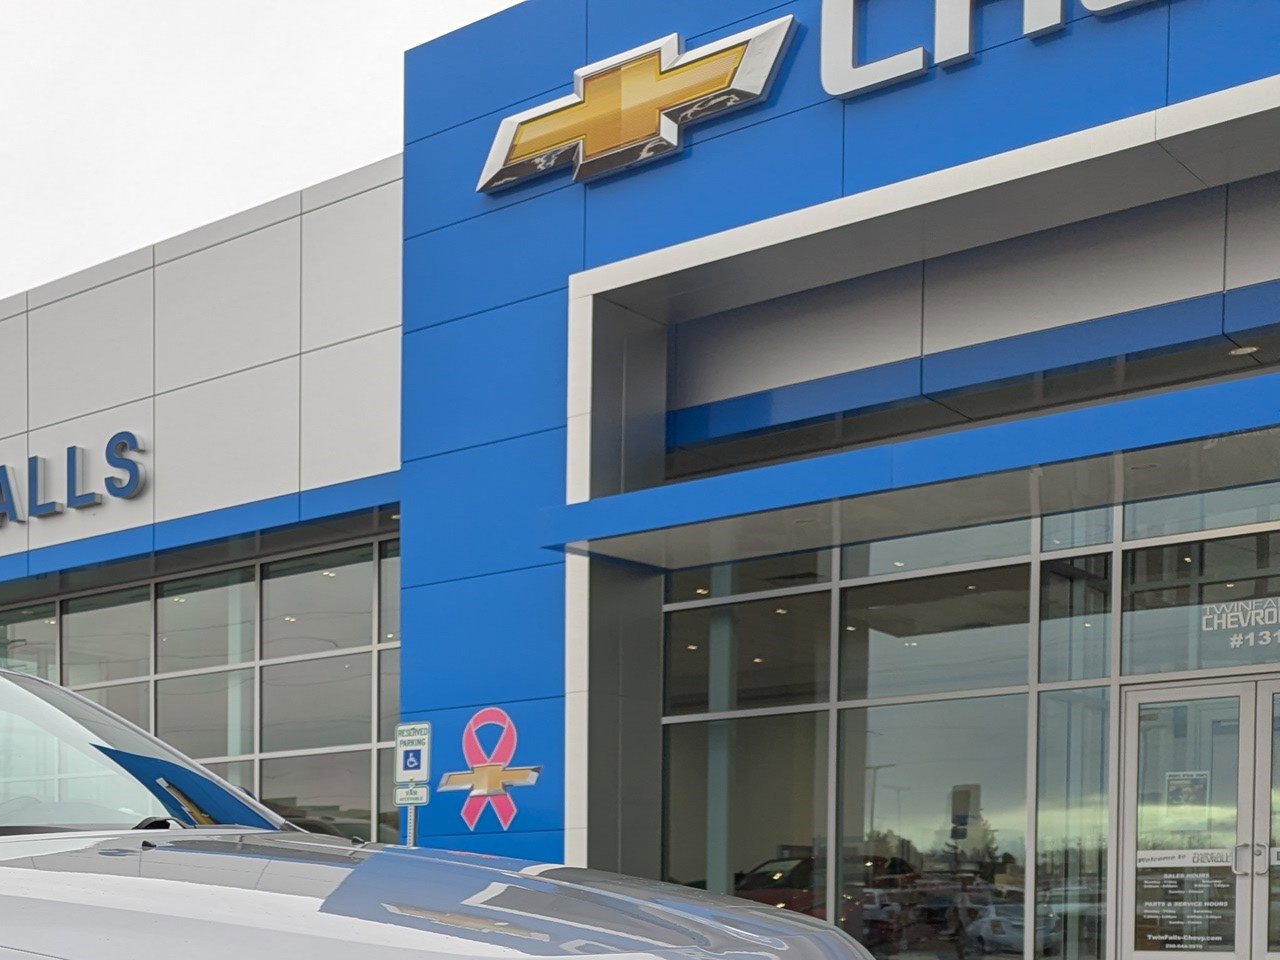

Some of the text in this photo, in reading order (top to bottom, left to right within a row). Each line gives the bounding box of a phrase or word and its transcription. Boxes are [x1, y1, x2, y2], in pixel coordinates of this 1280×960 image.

[1202, 598, 1280, 616] TWINFA
[1202, 607, 1280, 631] CHEVRO
[398, 727, 429, 737] RESERVED
[399, 738, 426, 748] PARKING
